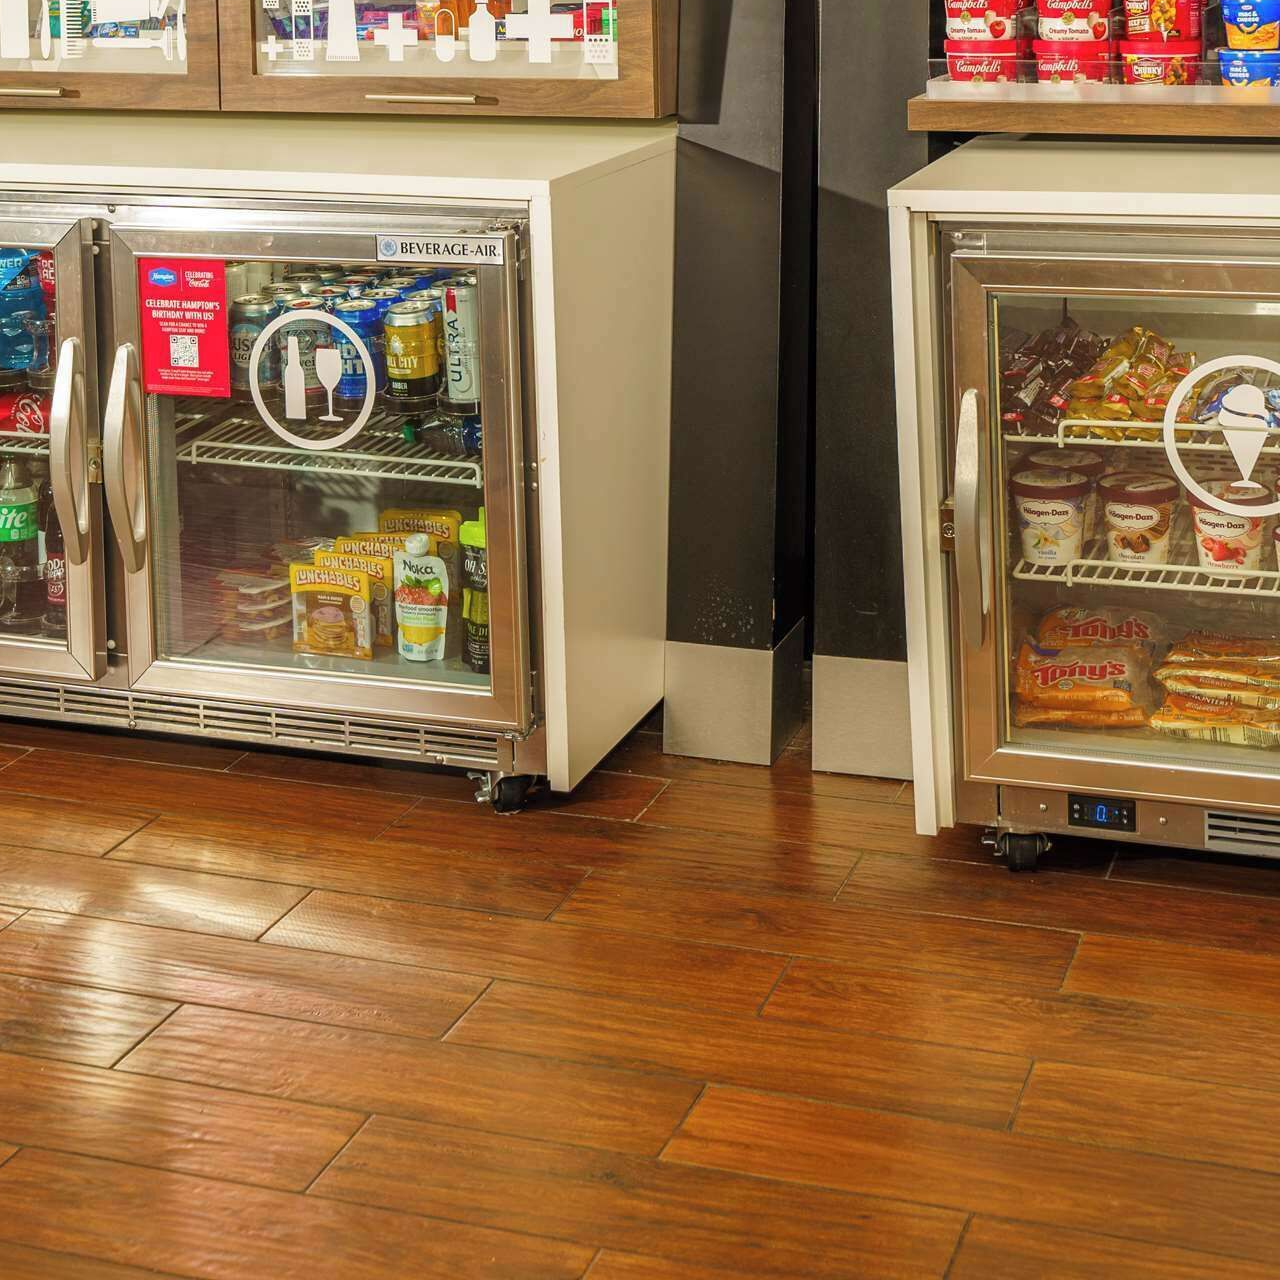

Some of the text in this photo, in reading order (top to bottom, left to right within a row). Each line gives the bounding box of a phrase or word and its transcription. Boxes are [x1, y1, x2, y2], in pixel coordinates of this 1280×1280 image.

[949, 26, 987, 35] Creamy Tomato
[1048, 27, 1068, 36] Creamy
[955, 58, 1002, 73] Campbell's
[1038, 60, 1079, 72] Campbell's
[1133, 65, 1163, 75] CHUNKY
[400, 241, 497, 258] BEVERAGE-AIR
[145, 299, 220, 310] CELEBRATE HAMPTON'S
[151, 310, 214, 321] BIRTHDAY WITH US!
[447, 318, 462, 382] ULTRA
[383, 518, 451, 537] LUNCHABLES
[402, 559, 436, 575] Noka
[296, 568, 361, 592] LUNCHABLES
[1070, 615, 1150, 641] Tony's
[1032, 660, 1128, 689] Tony's
